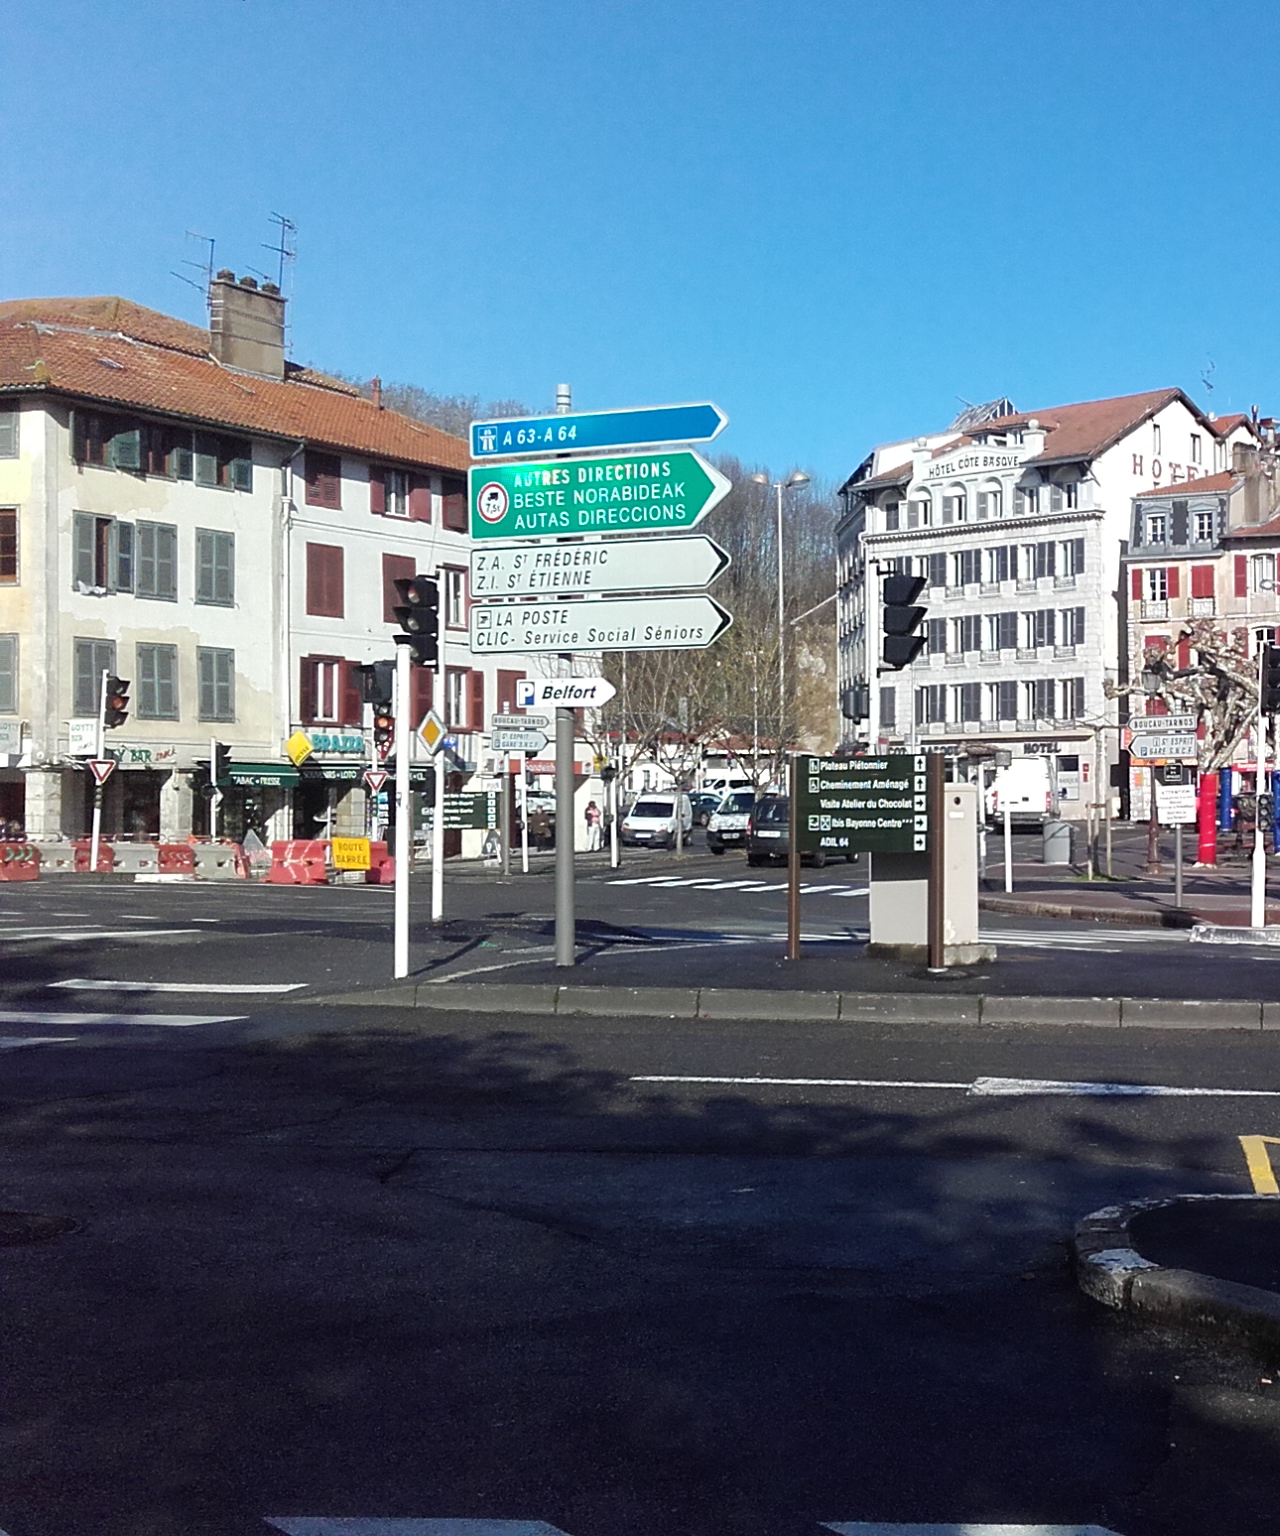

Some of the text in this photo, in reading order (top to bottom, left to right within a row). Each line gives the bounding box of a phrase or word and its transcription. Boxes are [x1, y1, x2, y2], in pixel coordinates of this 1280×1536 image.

[503, 431, 513, 446] A
[558, 425, 577, 441] 64
[929, 463, 955, 477] HÔTEL
[958, 454, 979, 469] CÔTE
[1132, 453, 1209, 485] HOTE
[514, 461, 671, 487] AUTRES DIRECTIONS
[514, 482, 686, 508] BESTE NORABIDEAK
[514, 504, 686, 529] AUTAS DIRECCIONS
[477, 556, 505, 571] Z.A.
[535, 549, 609, 567] FRÉDÉRIC
[477, 575, 500, 590] Z.I.
[529, 570, 592, 587] ÉTIENNE
[497, 610, 569, 626] LA POSTE
[524, 628, 579, 644] Service
[588, 626, 636, 642] Social
[644, 625, 704, 640] Séniors
[542, 684, 597, 700] Belfort
[494, 716, 544, 726] BOUCAU-TARNOS
[1134, 719, 1193, 729] BOUCAU-TARNOS
[1171, 737, 1194, 745] ESPRIT
[131, 750, 152, 762] BAR
[1149, 747, 1166, 755] GARE
[820, 759, 888, 770] Plateau Piétonnier
[232, 776, 254, 785] TABAC
[341, 770, 357, 779] LOTO
[820, 778, 909, 791] Cheminement Aménagé
[820, 798, 912, 809] Visite Atelier du Chocolat
[832, 819, 845, 827] Ibis
[846, 818, 877, 829] Bayonne
[338, 842, 364, 851] ROUTE
[820, 837, 849, 847] ADIL 64
